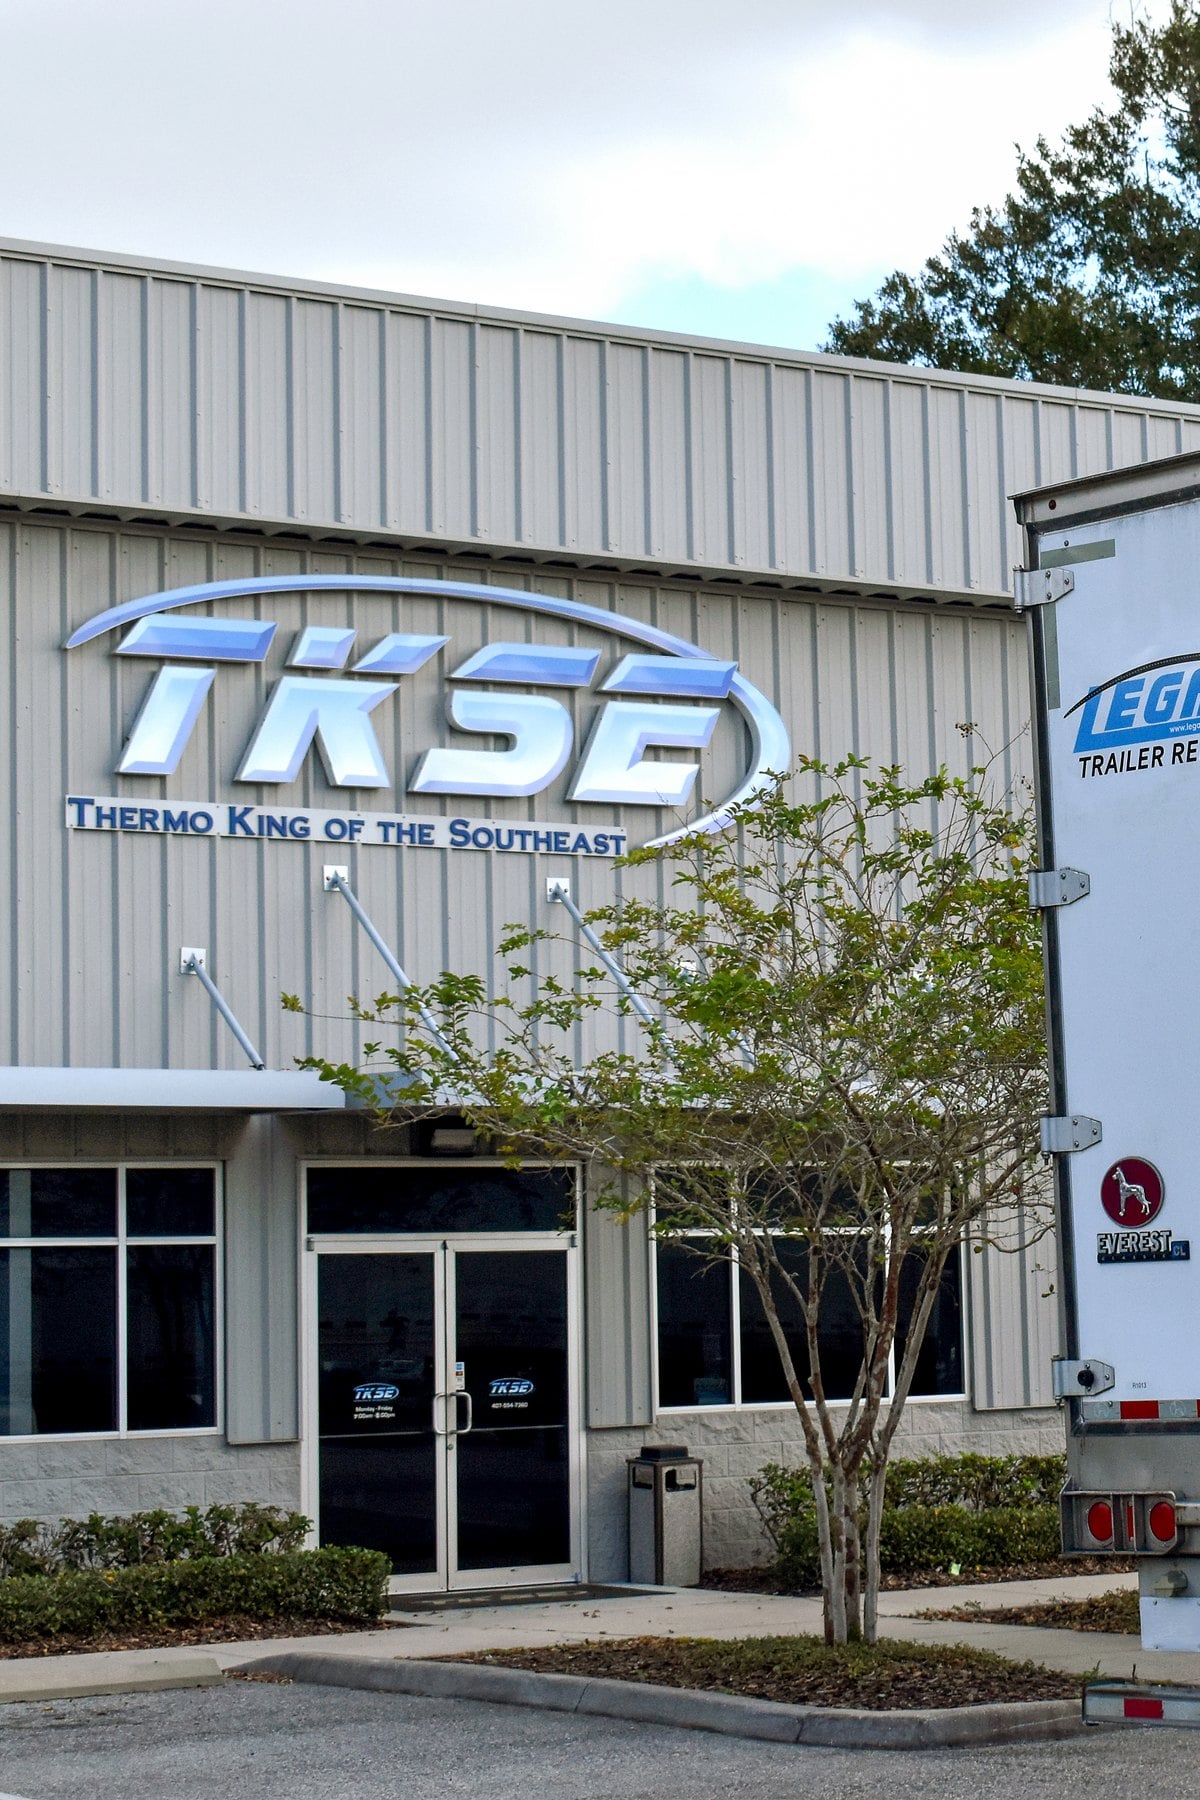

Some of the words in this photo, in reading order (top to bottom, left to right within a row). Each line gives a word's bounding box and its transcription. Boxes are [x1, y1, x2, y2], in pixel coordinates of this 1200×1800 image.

[115, 614, 738, 806] TKSE
[1079, 744, 1165, 779] TRAILER
[1097, 1230, 1172, 1254] EVEREST
[1173, 1244, 1187, 1256] CL
[355, 1386, 396, 1399] TKSE
[491, 1381, 530, 1394] TKSE
